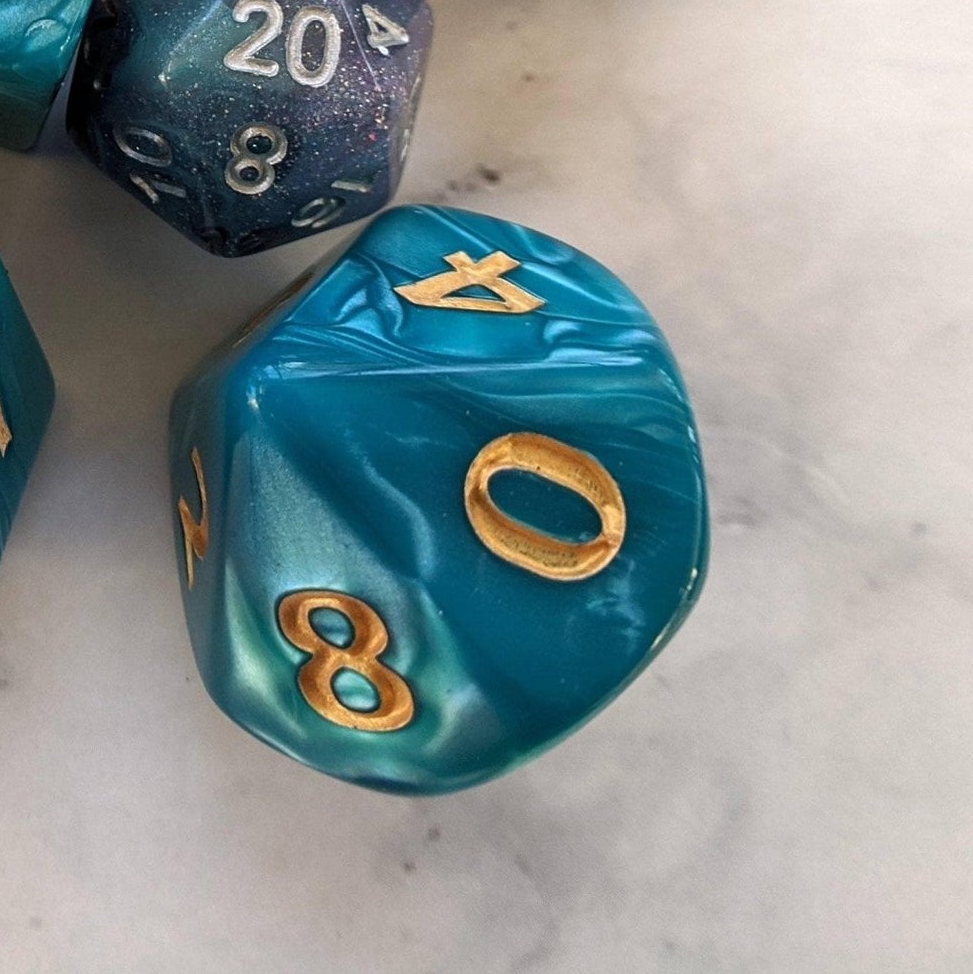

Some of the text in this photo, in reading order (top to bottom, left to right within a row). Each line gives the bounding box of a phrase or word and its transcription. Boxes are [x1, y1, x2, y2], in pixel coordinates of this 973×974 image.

[224, 125, 289, 195] 8
[393, 250, 547, 315] 4
[464, 431, 627, 582] 0
[278, 588, 416, 732] 8
